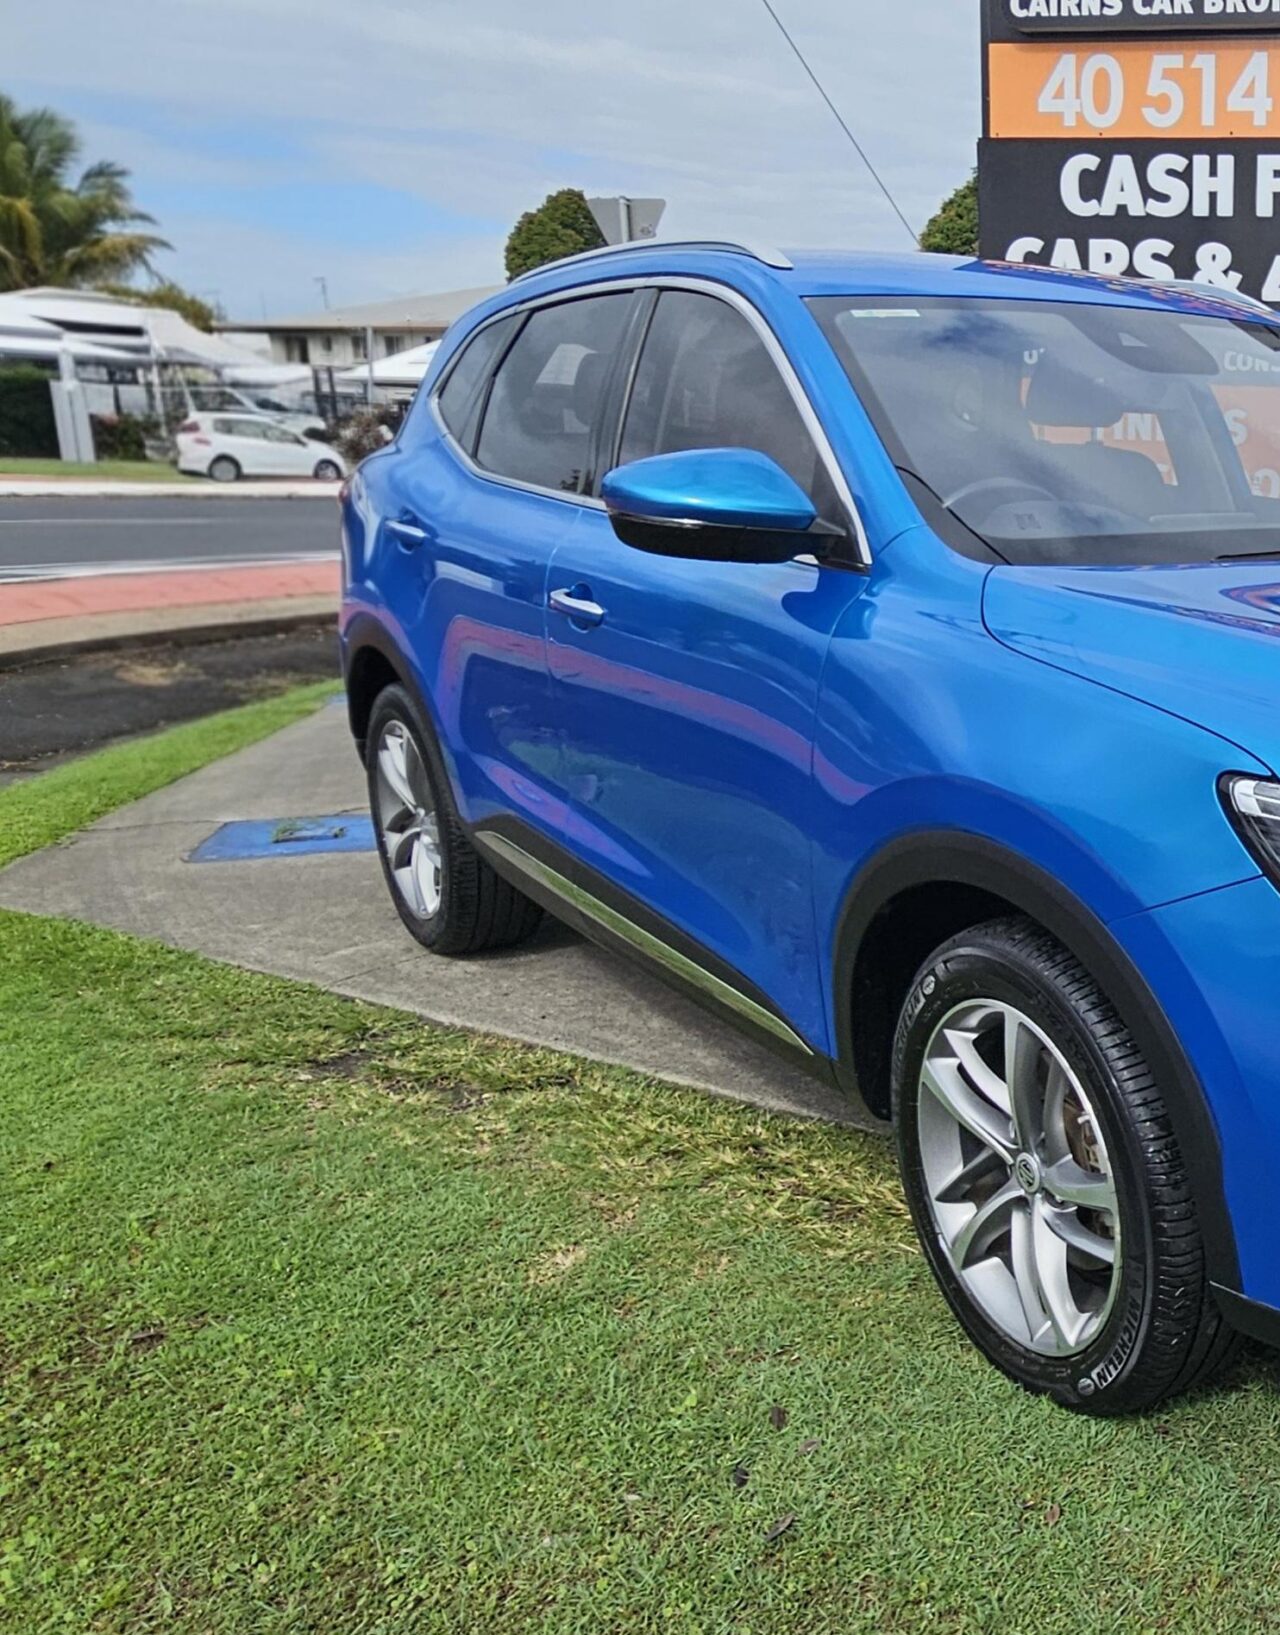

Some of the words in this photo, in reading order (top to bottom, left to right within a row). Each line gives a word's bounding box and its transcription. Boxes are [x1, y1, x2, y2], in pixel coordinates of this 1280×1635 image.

[1010, 0, 1123, 17] CAIRNS
[1132, 0, 1194, 15] CAR
[1038, 53, 1124, 128] 40
[1141, 52, 1273, 127] 514
[1059, 153, 1235, 218] CASH
[1193, 242, 1243, 292] &
[1096, 1294, 1141, 1389] MICHELIN
